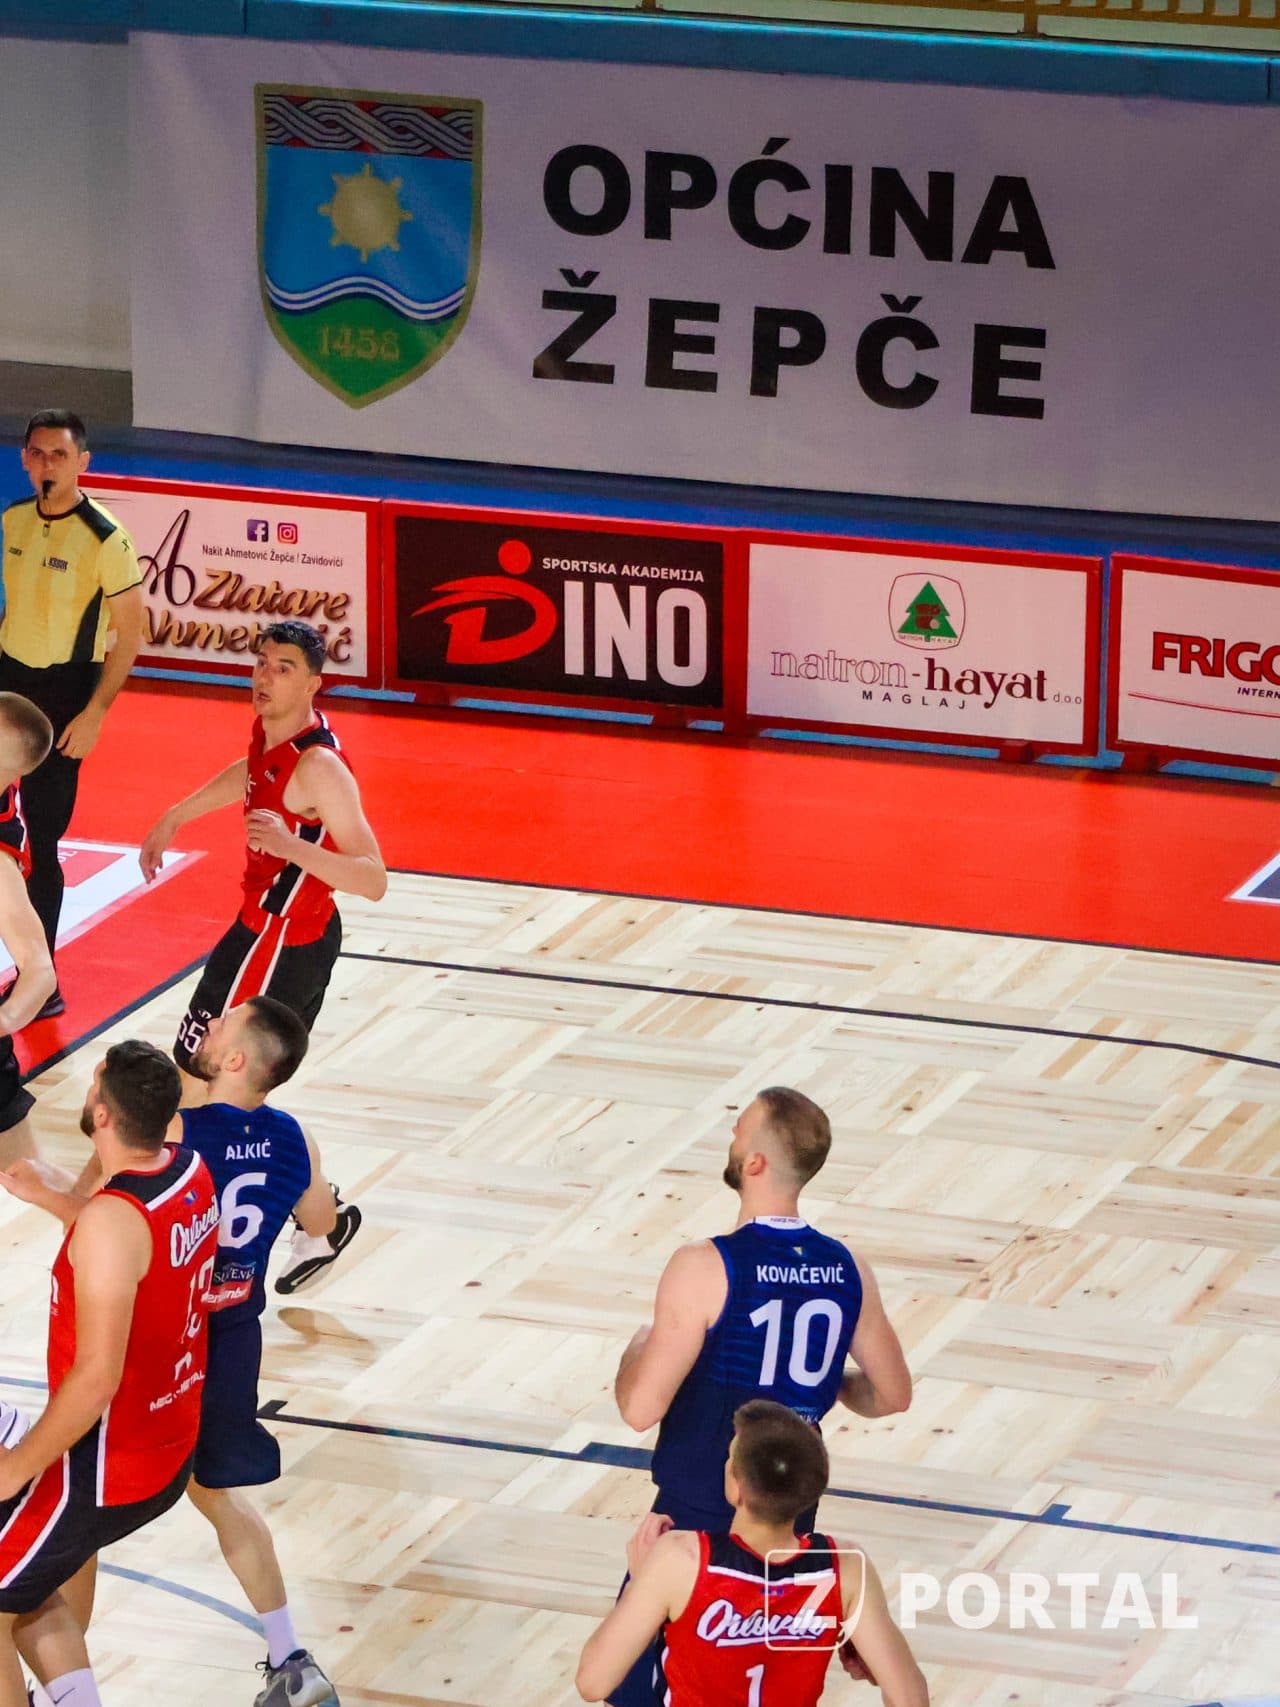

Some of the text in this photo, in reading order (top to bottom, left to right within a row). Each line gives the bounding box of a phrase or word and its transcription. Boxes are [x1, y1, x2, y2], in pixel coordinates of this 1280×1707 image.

[542, 137, 1056, 270] OPĆINA
[532, 268, 1046, 420] ŽEPČE
[202, 545, 223, 557] Nakit
[224, 547, 268, 561] Ahmetović
[301, 554, 344, 568] Zavidovići
[542, 557, 704, 583] SPORTSKA AKADEMIJA
[862, 690, 968, 709] MAGLAJ
[224, 1138, 270, 1161] ALKIĆ
[218, 1172, 267, 1249] 6
[756, 1263, 845, 1284] KOVAČEVIĆ
[749, 1298, 843, 1387] 10
[745, 1663, 765, 1707] 1
